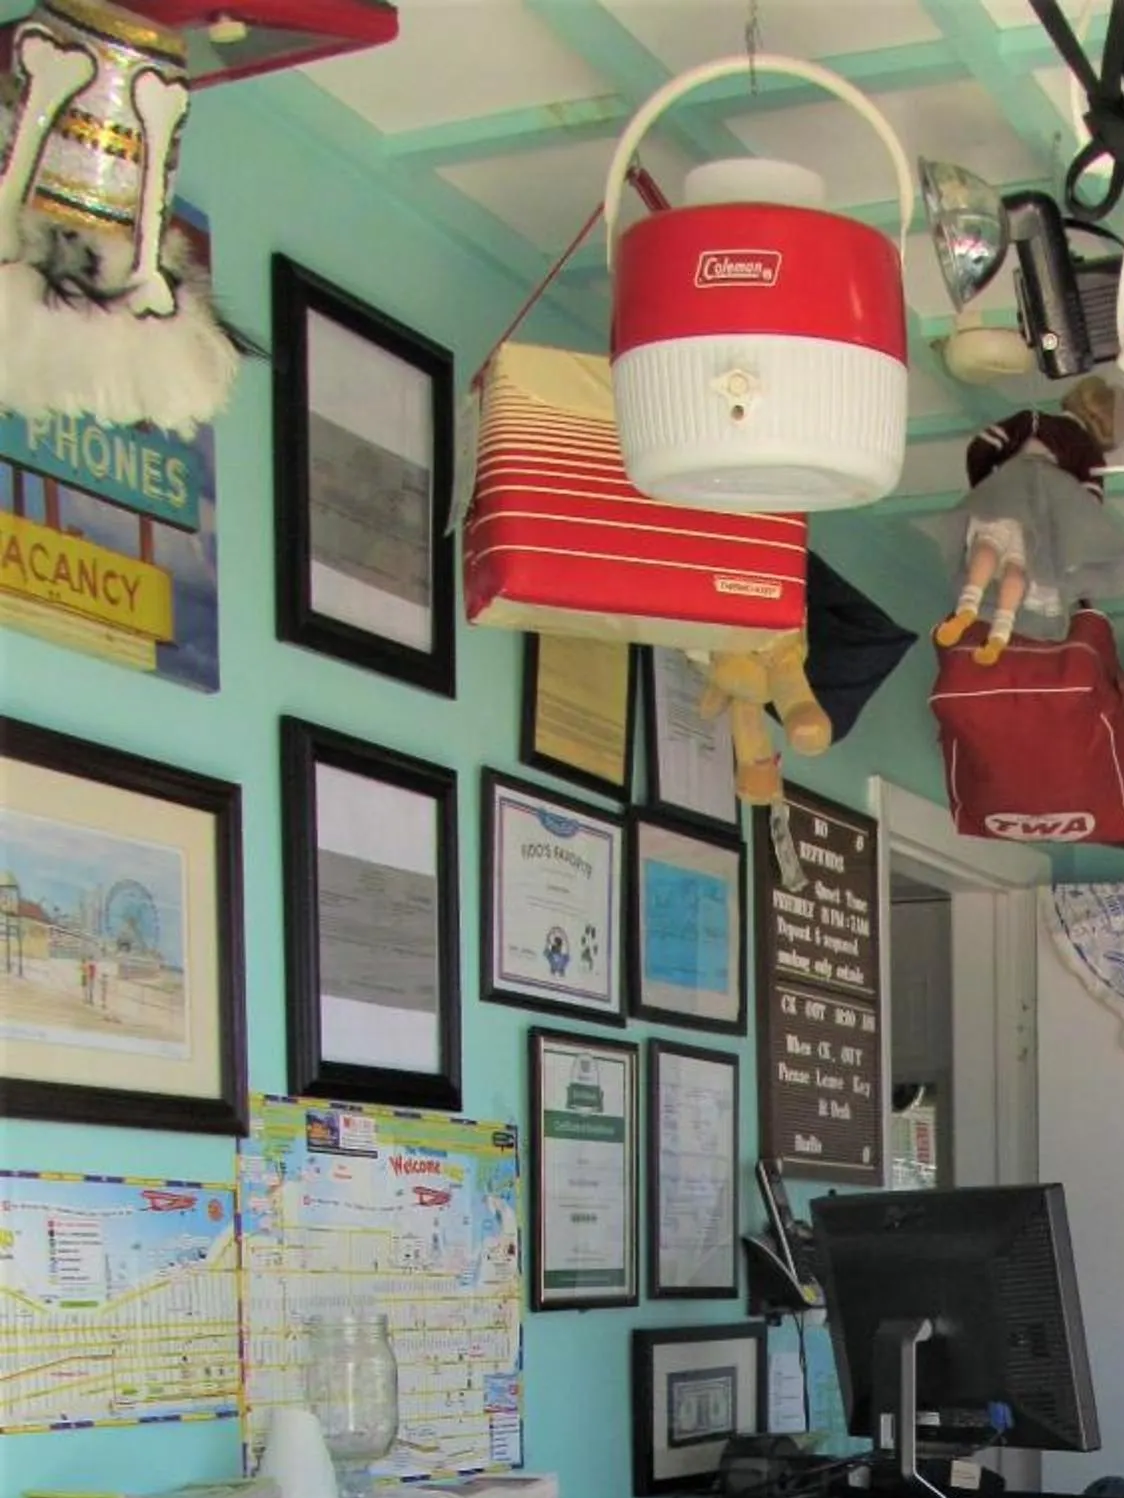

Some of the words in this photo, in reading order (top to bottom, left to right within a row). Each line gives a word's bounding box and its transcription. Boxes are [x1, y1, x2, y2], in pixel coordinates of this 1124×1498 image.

[704, 256, 762, 280] Coleman
[27, 413, 188, 508] PHONES
[0, 533, 141, 612] ACANCY
[991, 816, 1088, 834] TWA
[800, 841, 845, 873] REFUNDS
[389, 1155, 441, 1177] Welcome
